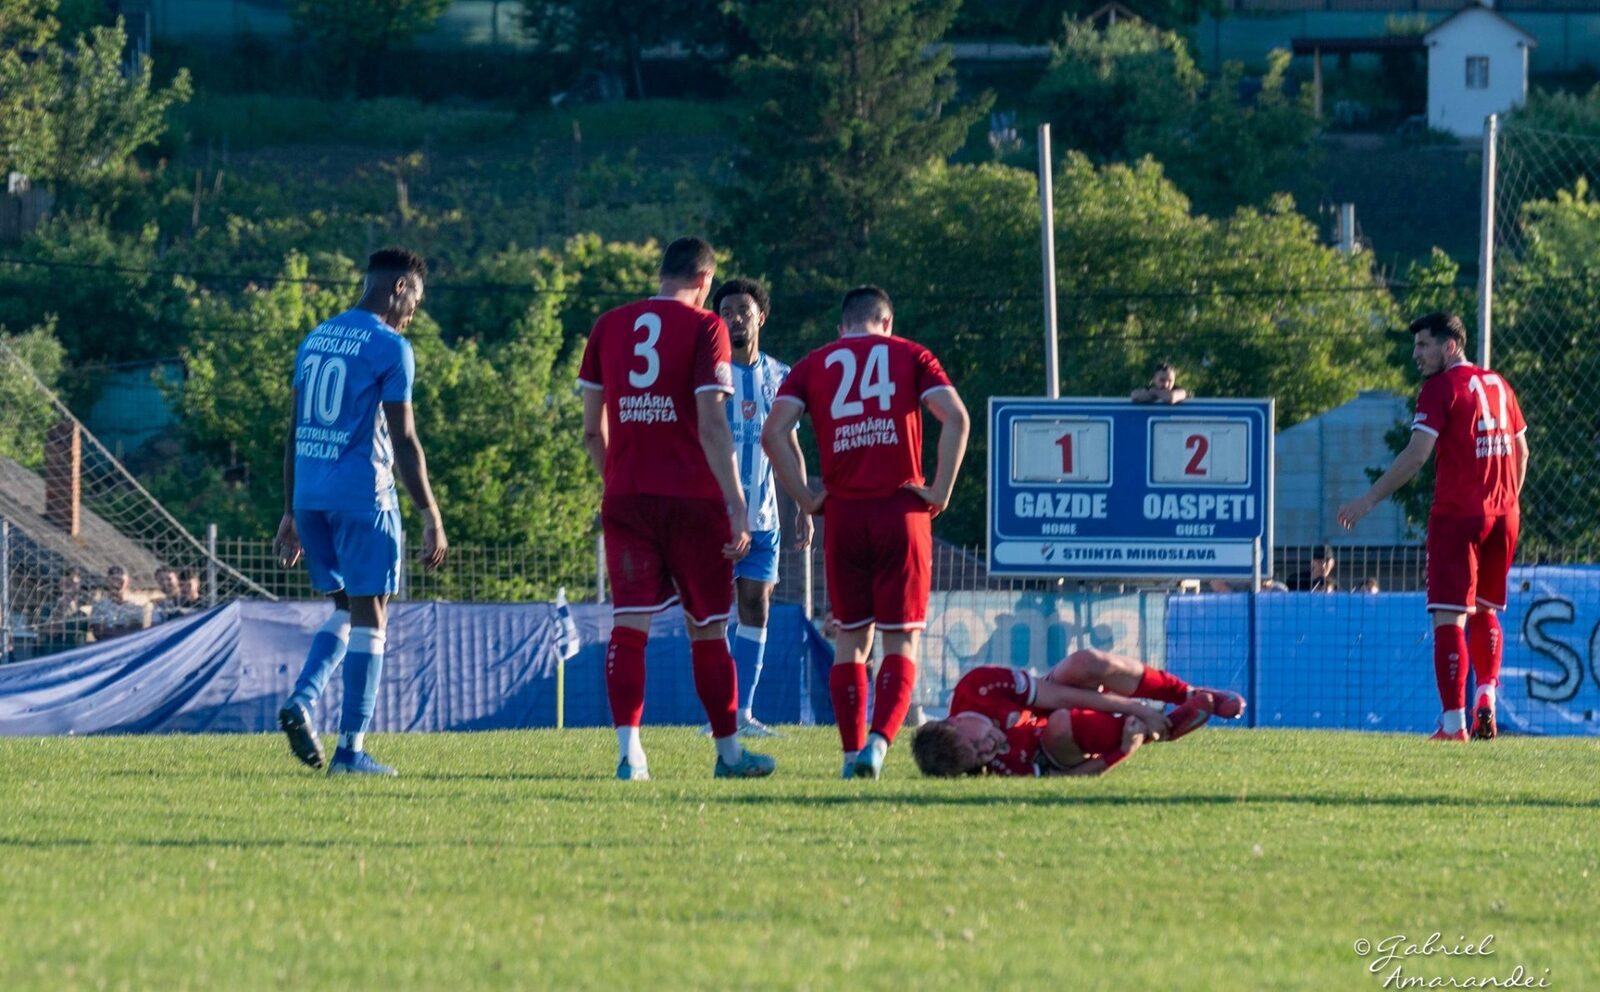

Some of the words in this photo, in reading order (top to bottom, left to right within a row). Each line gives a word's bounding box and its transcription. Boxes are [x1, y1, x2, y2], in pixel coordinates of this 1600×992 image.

[345, 328, 372, 343] LOCAL
[628, 312, 662, 389] 3
[301, 353, 348, 426] 10
[824, 344, 896, 420] 24
[1468, 374, 1508, 432] 17
[834, 416, 896, 440] PRIMĂRIA
[1055, 433, 1074, 475] 1
[1184, 434, 1209, 476] 2
[1014, 492, 1108, 519] GAZDE
[1041, 523, 1078, 536] HOME
[1175, 523, 1217, 536] GUEST
[1126, 547, 1217, 561] MIROSLAVA
